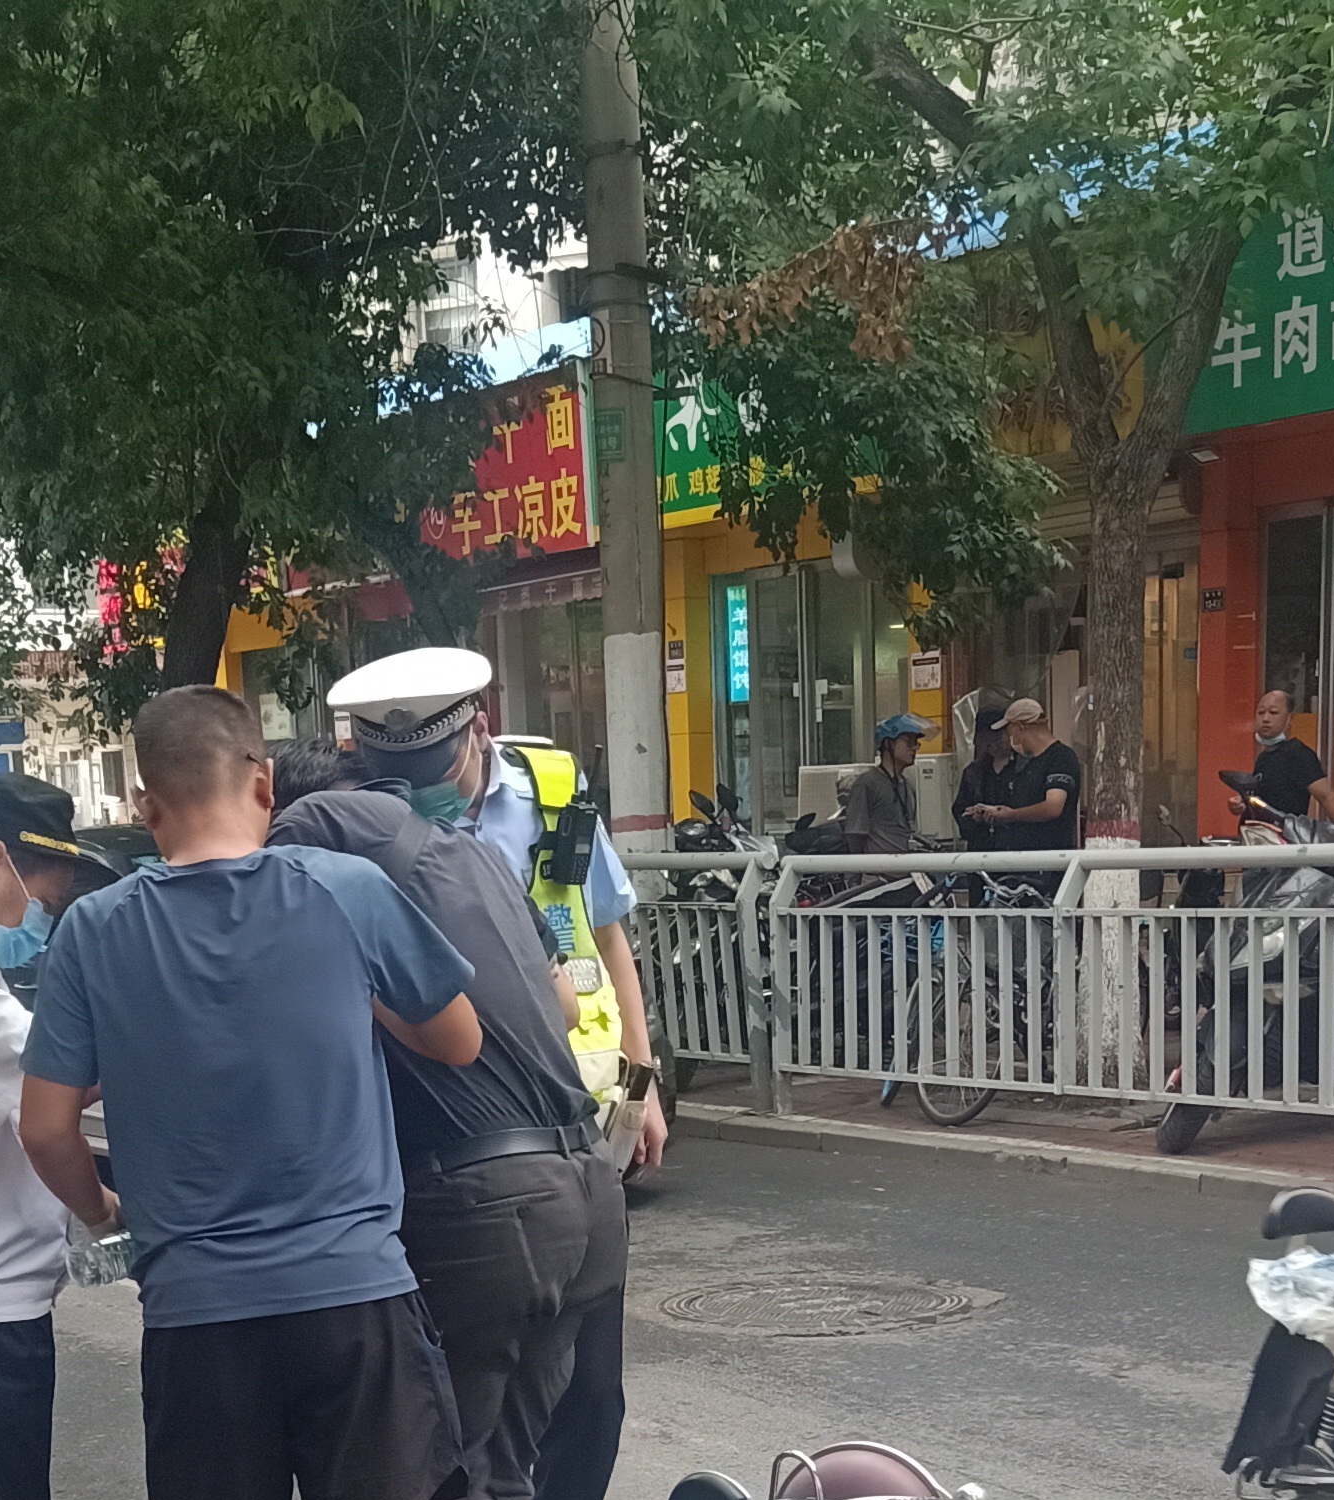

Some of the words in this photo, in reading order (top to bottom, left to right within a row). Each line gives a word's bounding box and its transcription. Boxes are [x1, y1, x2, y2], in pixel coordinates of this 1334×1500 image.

[451, 467, 582, 555] 手工凉皮
[544, 903, 576, 953] 警
